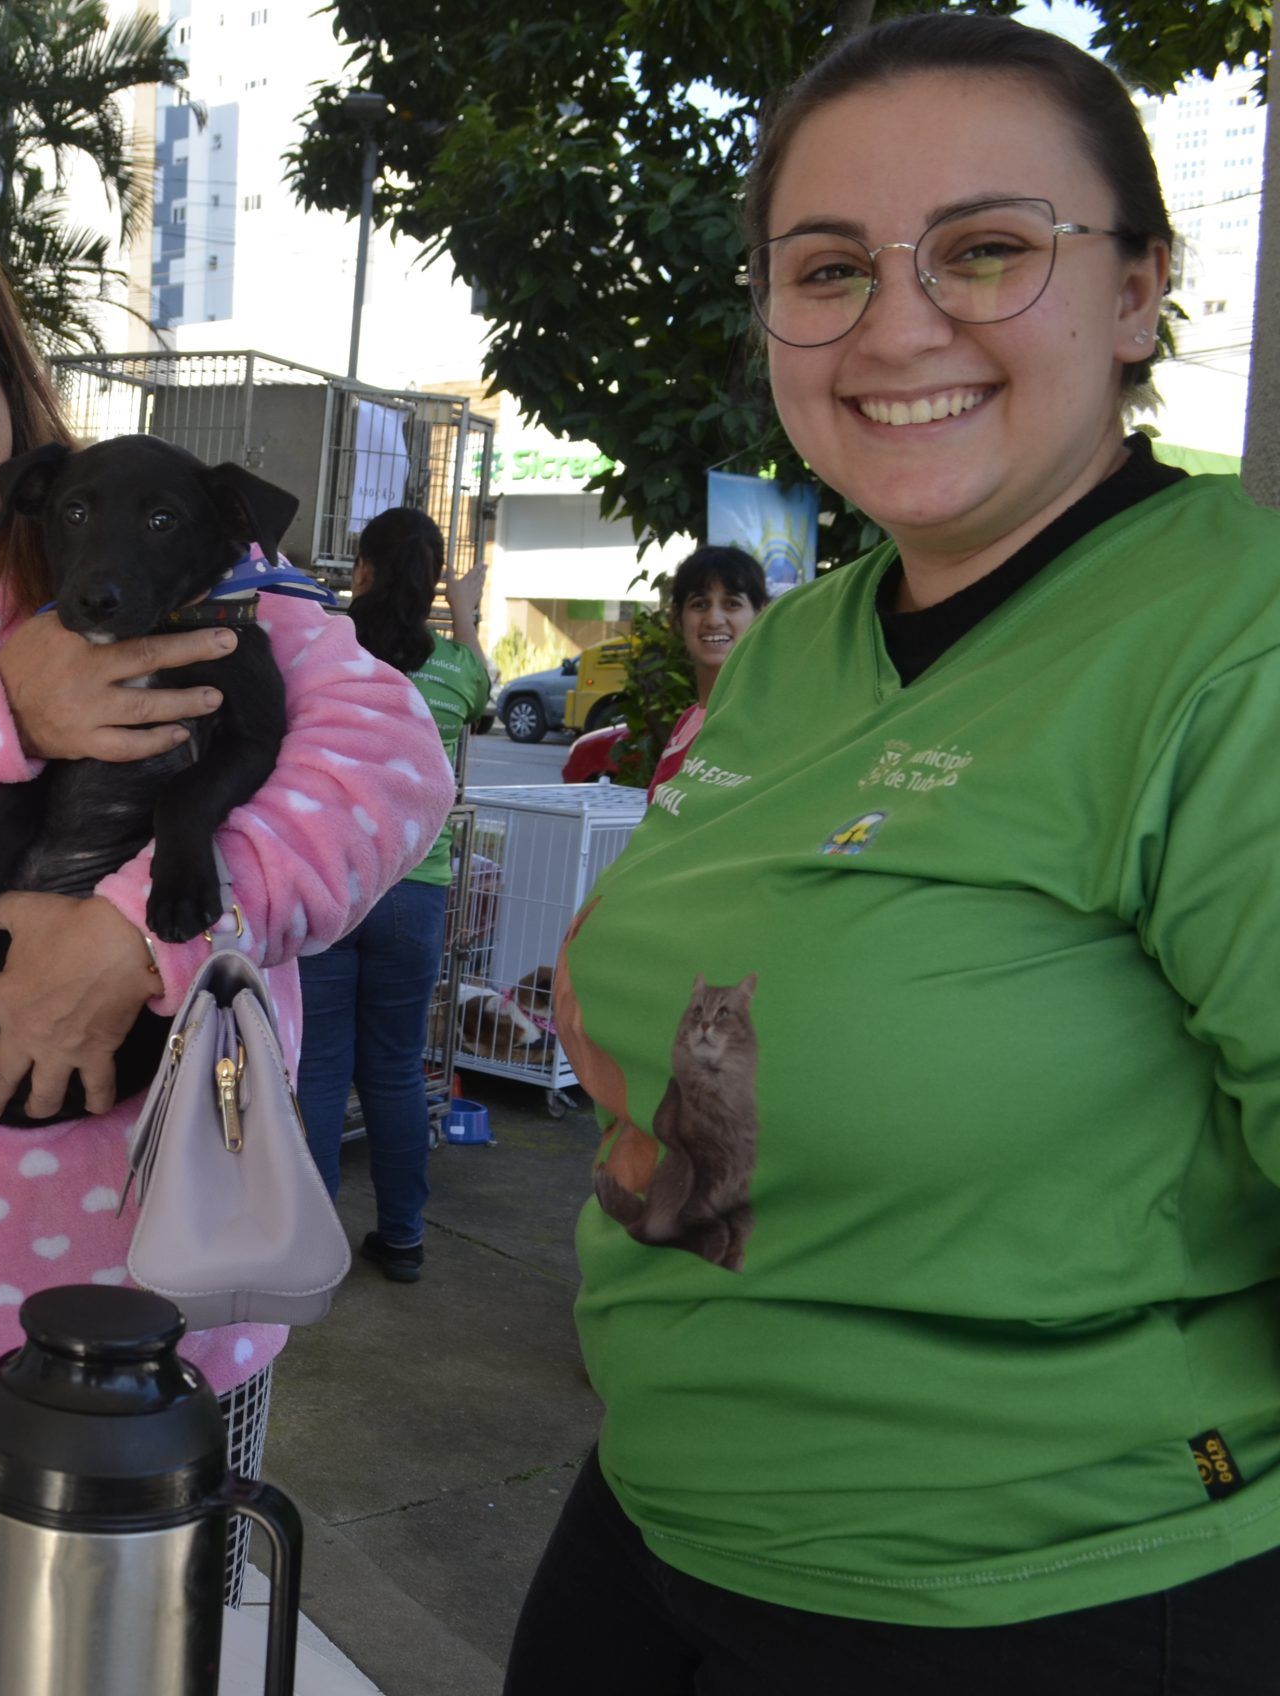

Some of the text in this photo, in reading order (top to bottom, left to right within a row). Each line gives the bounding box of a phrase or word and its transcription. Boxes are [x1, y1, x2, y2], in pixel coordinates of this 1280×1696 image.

[512, 449, 607, 481] Sicred
[884, 766, 906, 789] de
[652, 783, 688, 817] MAL
